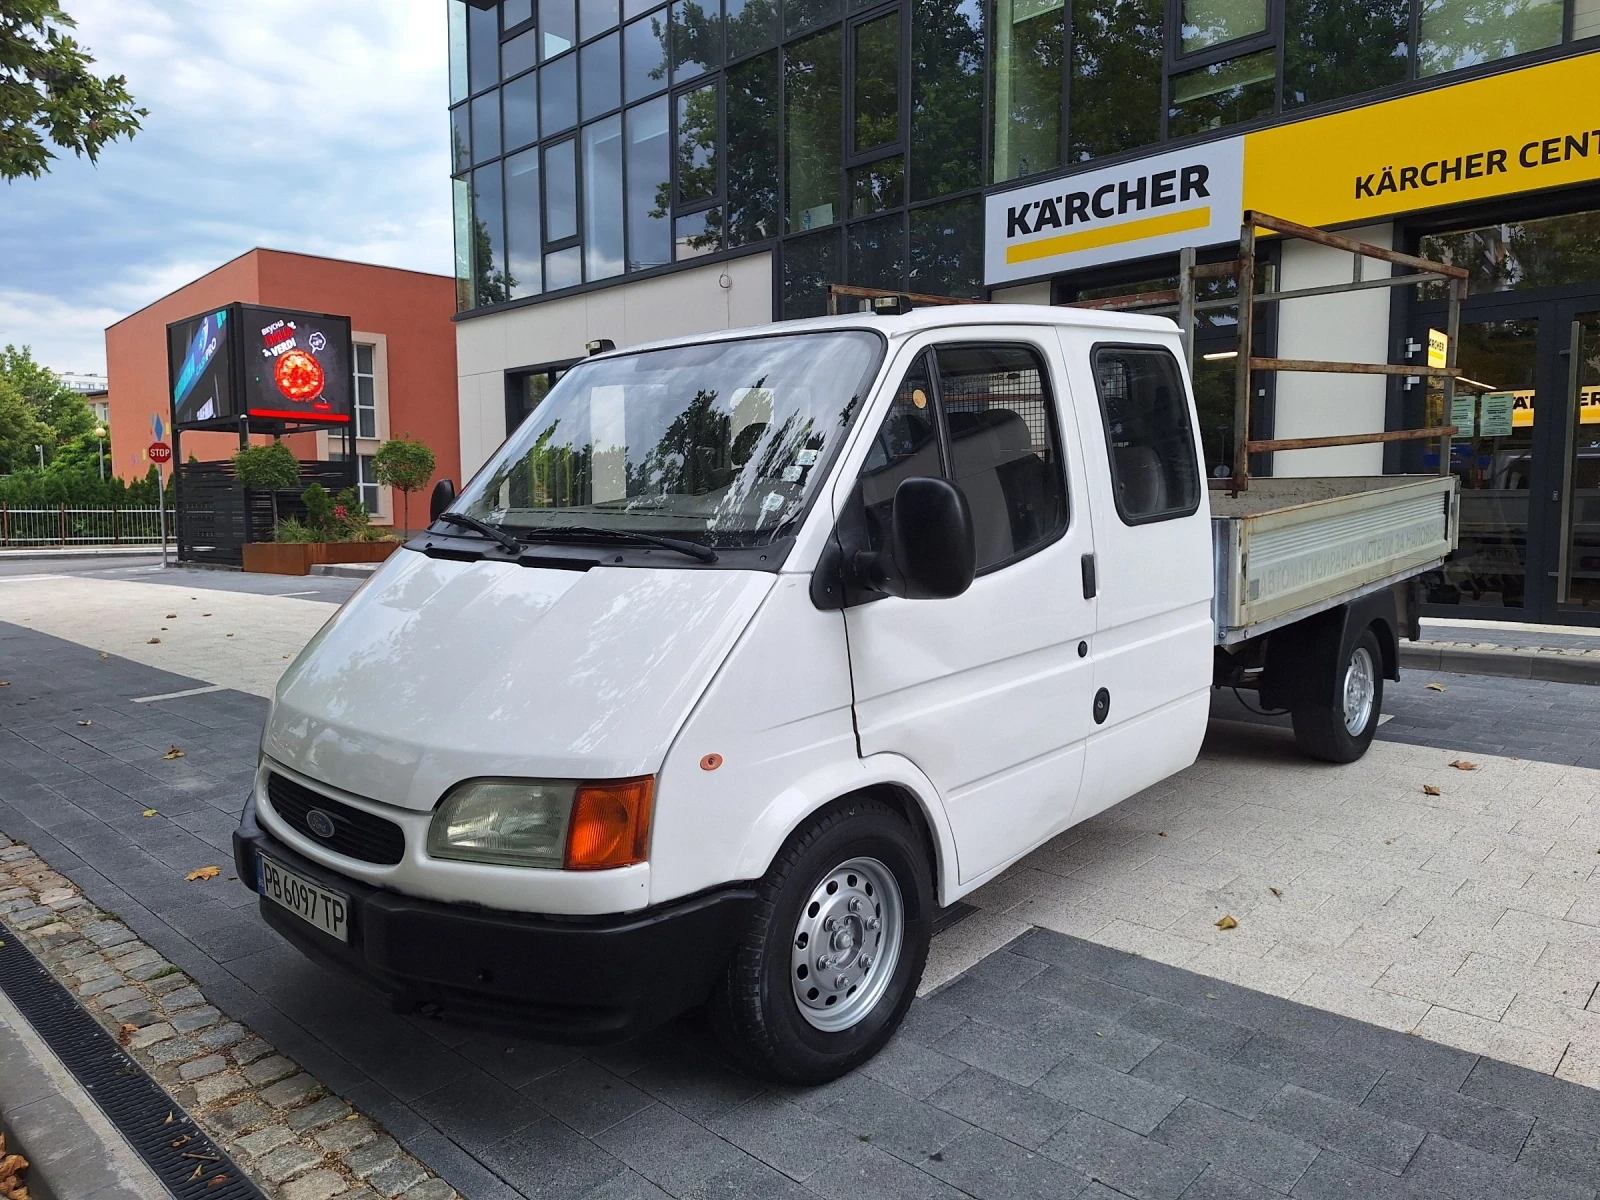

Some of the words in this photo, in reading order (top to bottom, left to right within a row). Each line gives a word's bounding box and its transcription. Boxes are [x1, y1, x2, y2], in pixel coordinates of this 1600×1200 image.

[1355, 148, 1507, 200] KÄRCHER
[1007, 163, 1211, 238] KÄRCHER
[270, 337, 297, 357] VERDI
[150, 448, 170, 457] STOP
[264, 862, 282, 899] PB
[284, 875, 318, 919] 6097
[320, 894, 344, 932] TP
